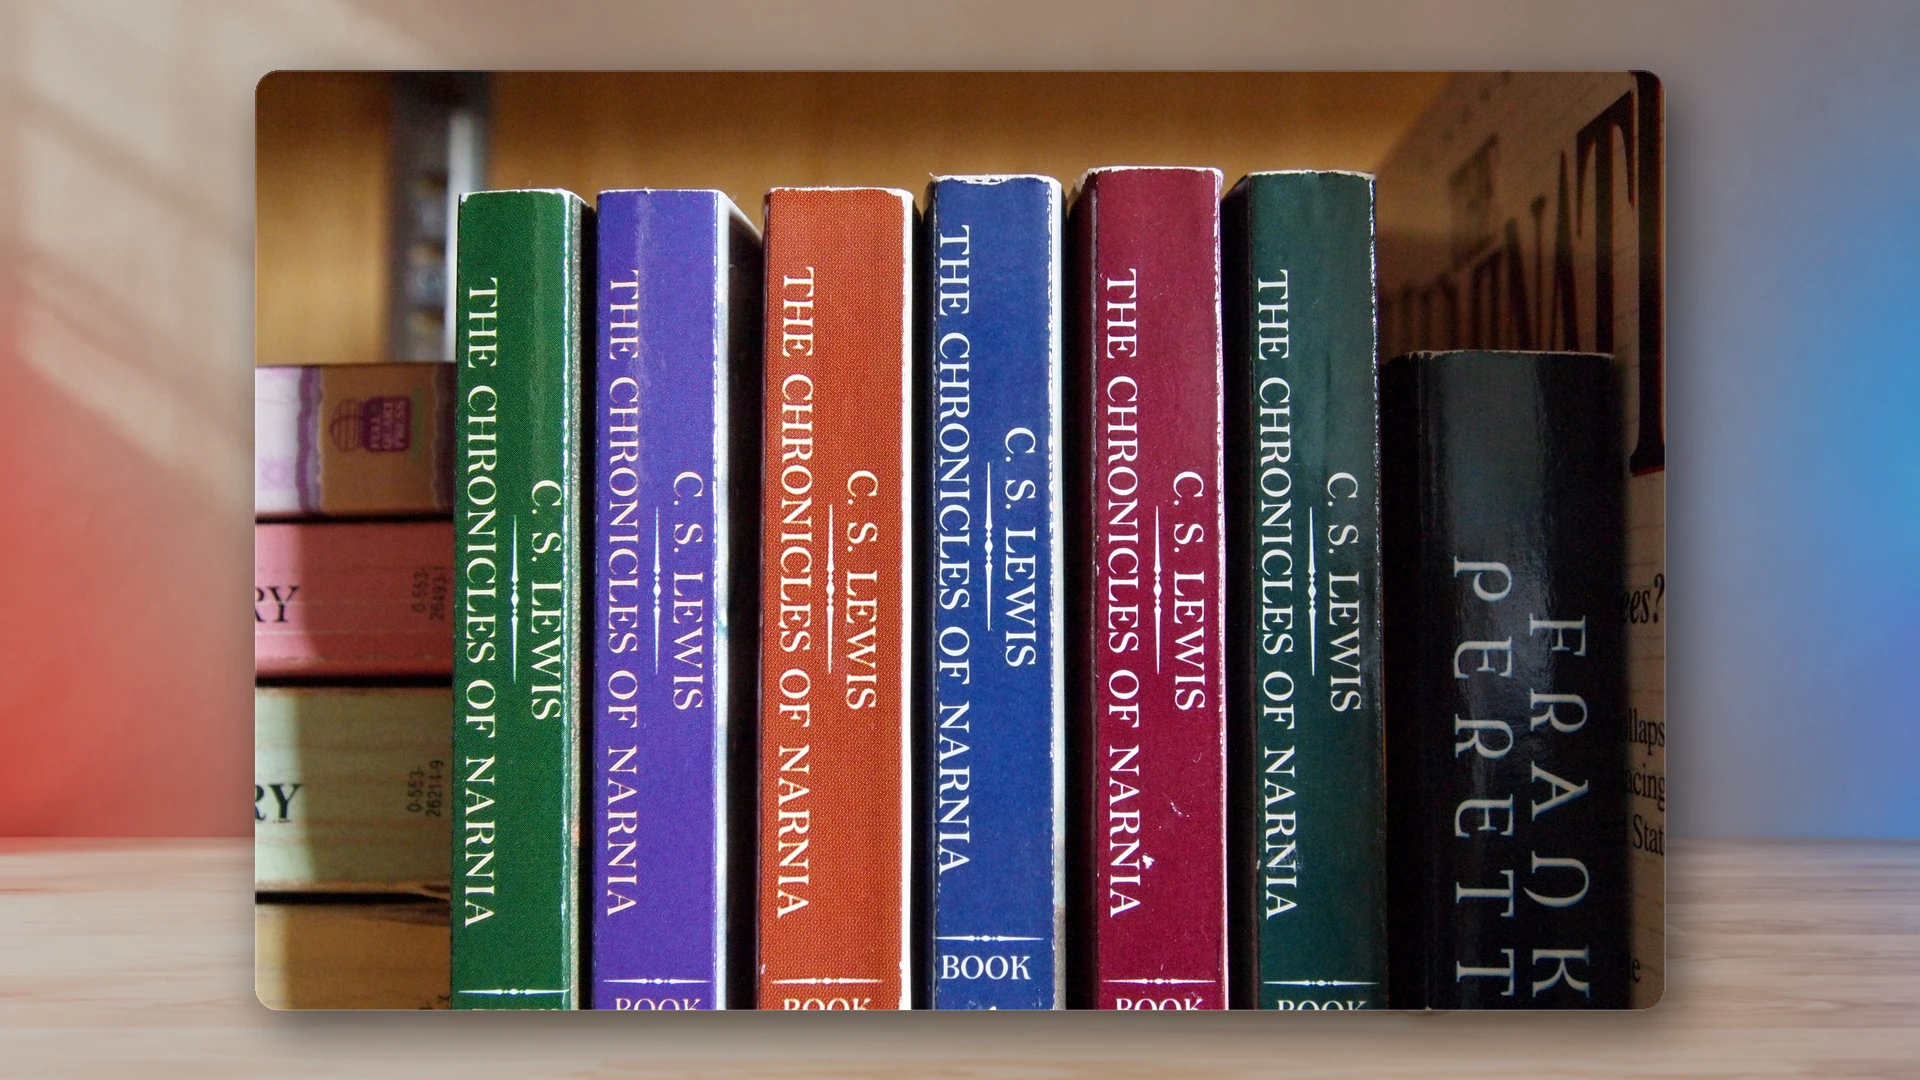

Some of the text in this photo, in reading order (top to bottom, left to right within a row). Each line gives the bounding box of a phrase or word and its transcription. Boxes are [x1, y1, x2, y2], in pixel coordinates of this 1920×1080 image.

[464, 277, 498, 928] THE CHRONICLES OF NARNIA
[531, 479, 562, 720] C. S. LEWIS
[607, 269, 639, 917] THE CHRONICLES OF NARNIA
[673, 471, 704, 710] C. S. LEWIS
[777, 266, 815, 918] THE CHRONICLES OF NARNIA
[846, 470, 879, 710] C. S. LEWIS
[939, 225, 970, 876] THE CHRONICLES OF NARNIA
[1005, 427, 1037, 667] C. S. LEWIS
[1107, 268, 1141, 918] THE CHRONICLES OF NARNIA
[1173, 471, 1206, 711] C. S. LEWIS
[1258, 269, 1298, 920] THE CHRONICLES OF NARNIA
[1327, 472, 1362, 712] C. S. LEWIS
[940, 954, 1031, 980] BOOK
[1453, 555, 1516, 997] PERETT
[1523, 613, 1590, 998] FRANK
